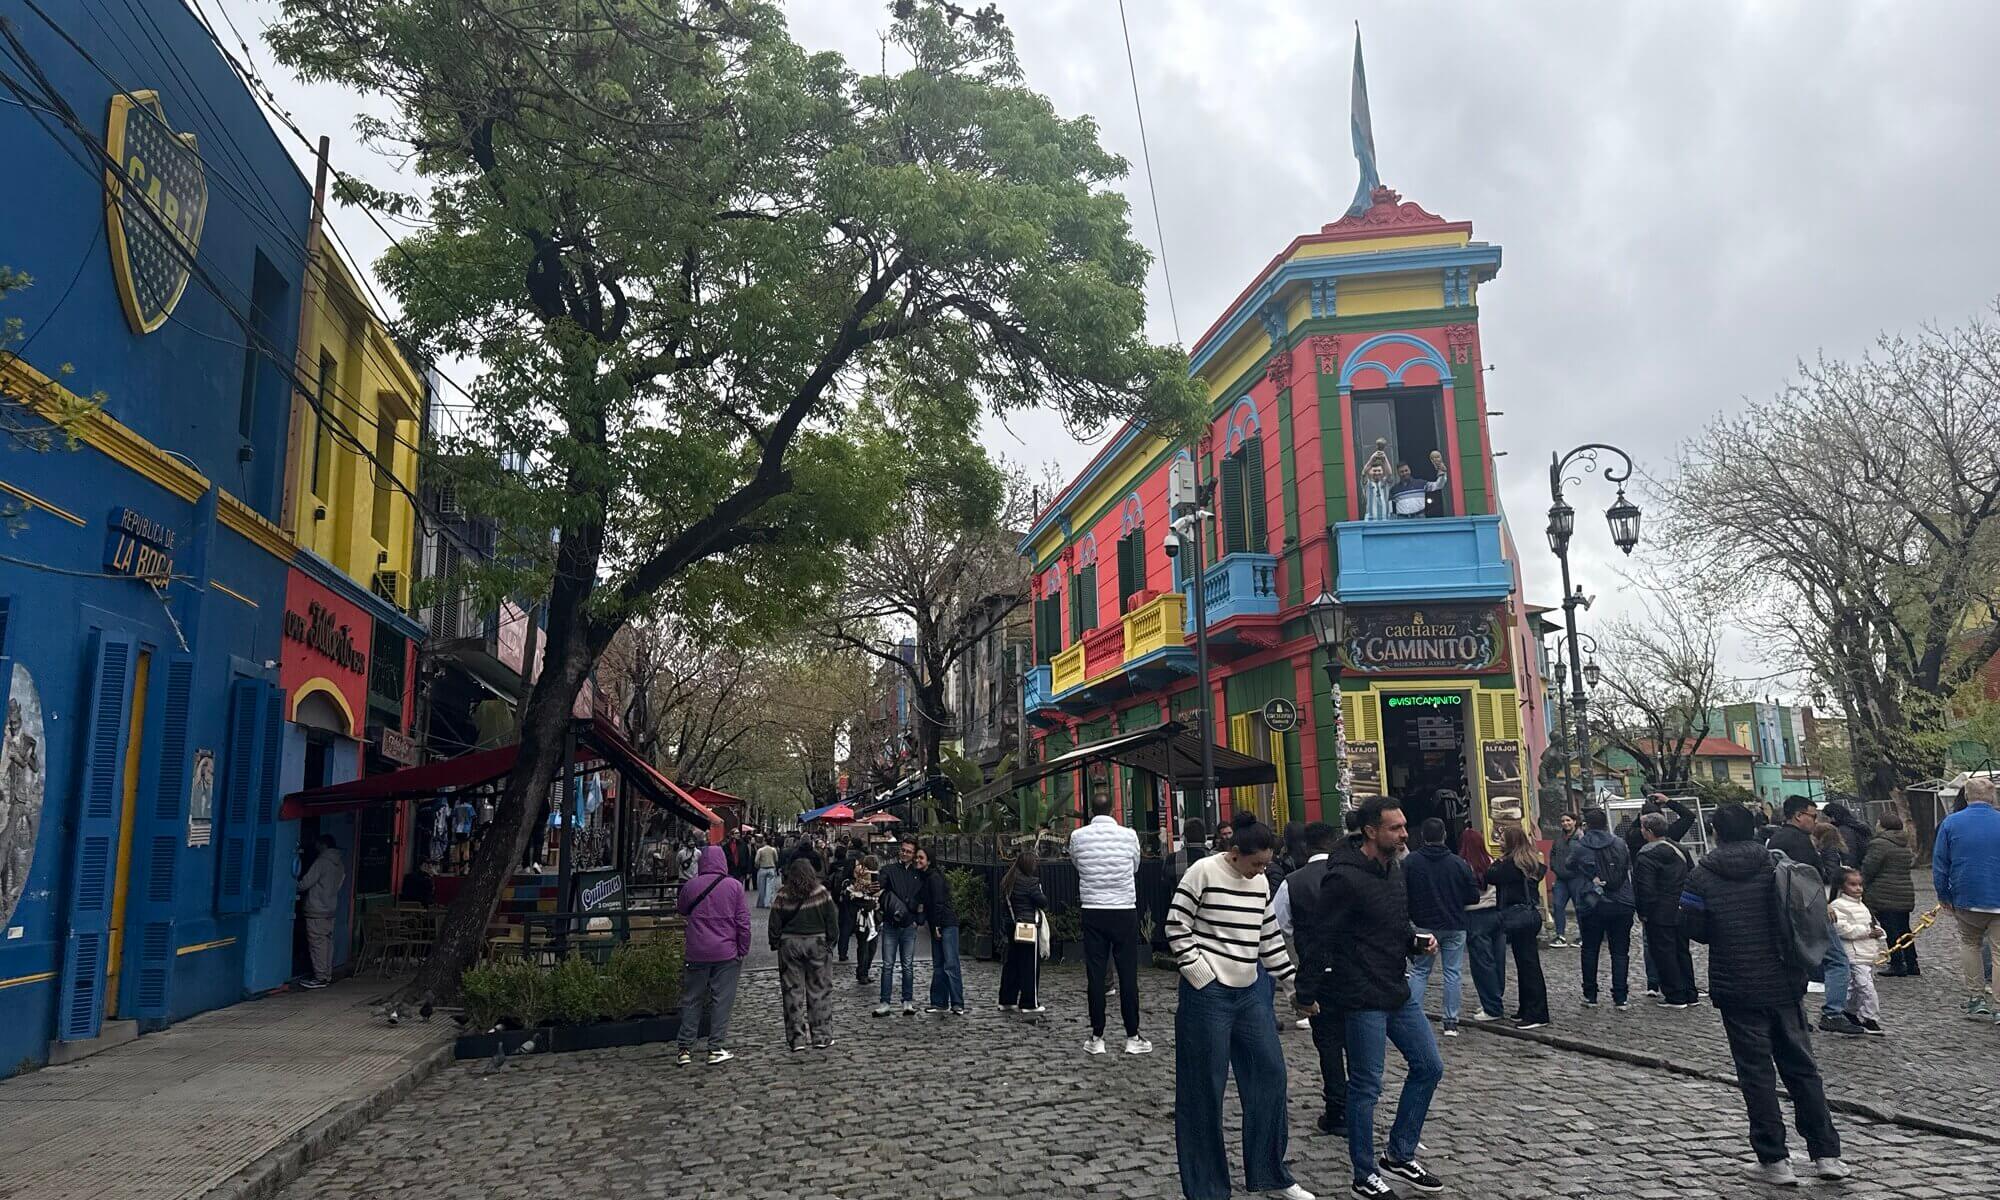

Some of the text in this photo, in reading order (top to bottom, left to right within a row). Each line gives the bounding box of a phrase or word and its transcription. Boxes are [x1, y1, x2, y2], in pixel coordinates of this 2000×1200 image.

[165, 527, 176, 550] DE
[113, 533, 174, 591] LA BOCA
[1366, 635, 1478, 662] CAMINITO
[1388, 695, 1462, 708] @VISITCAMINITO
[581, 874, 621, 911] Quilmes
